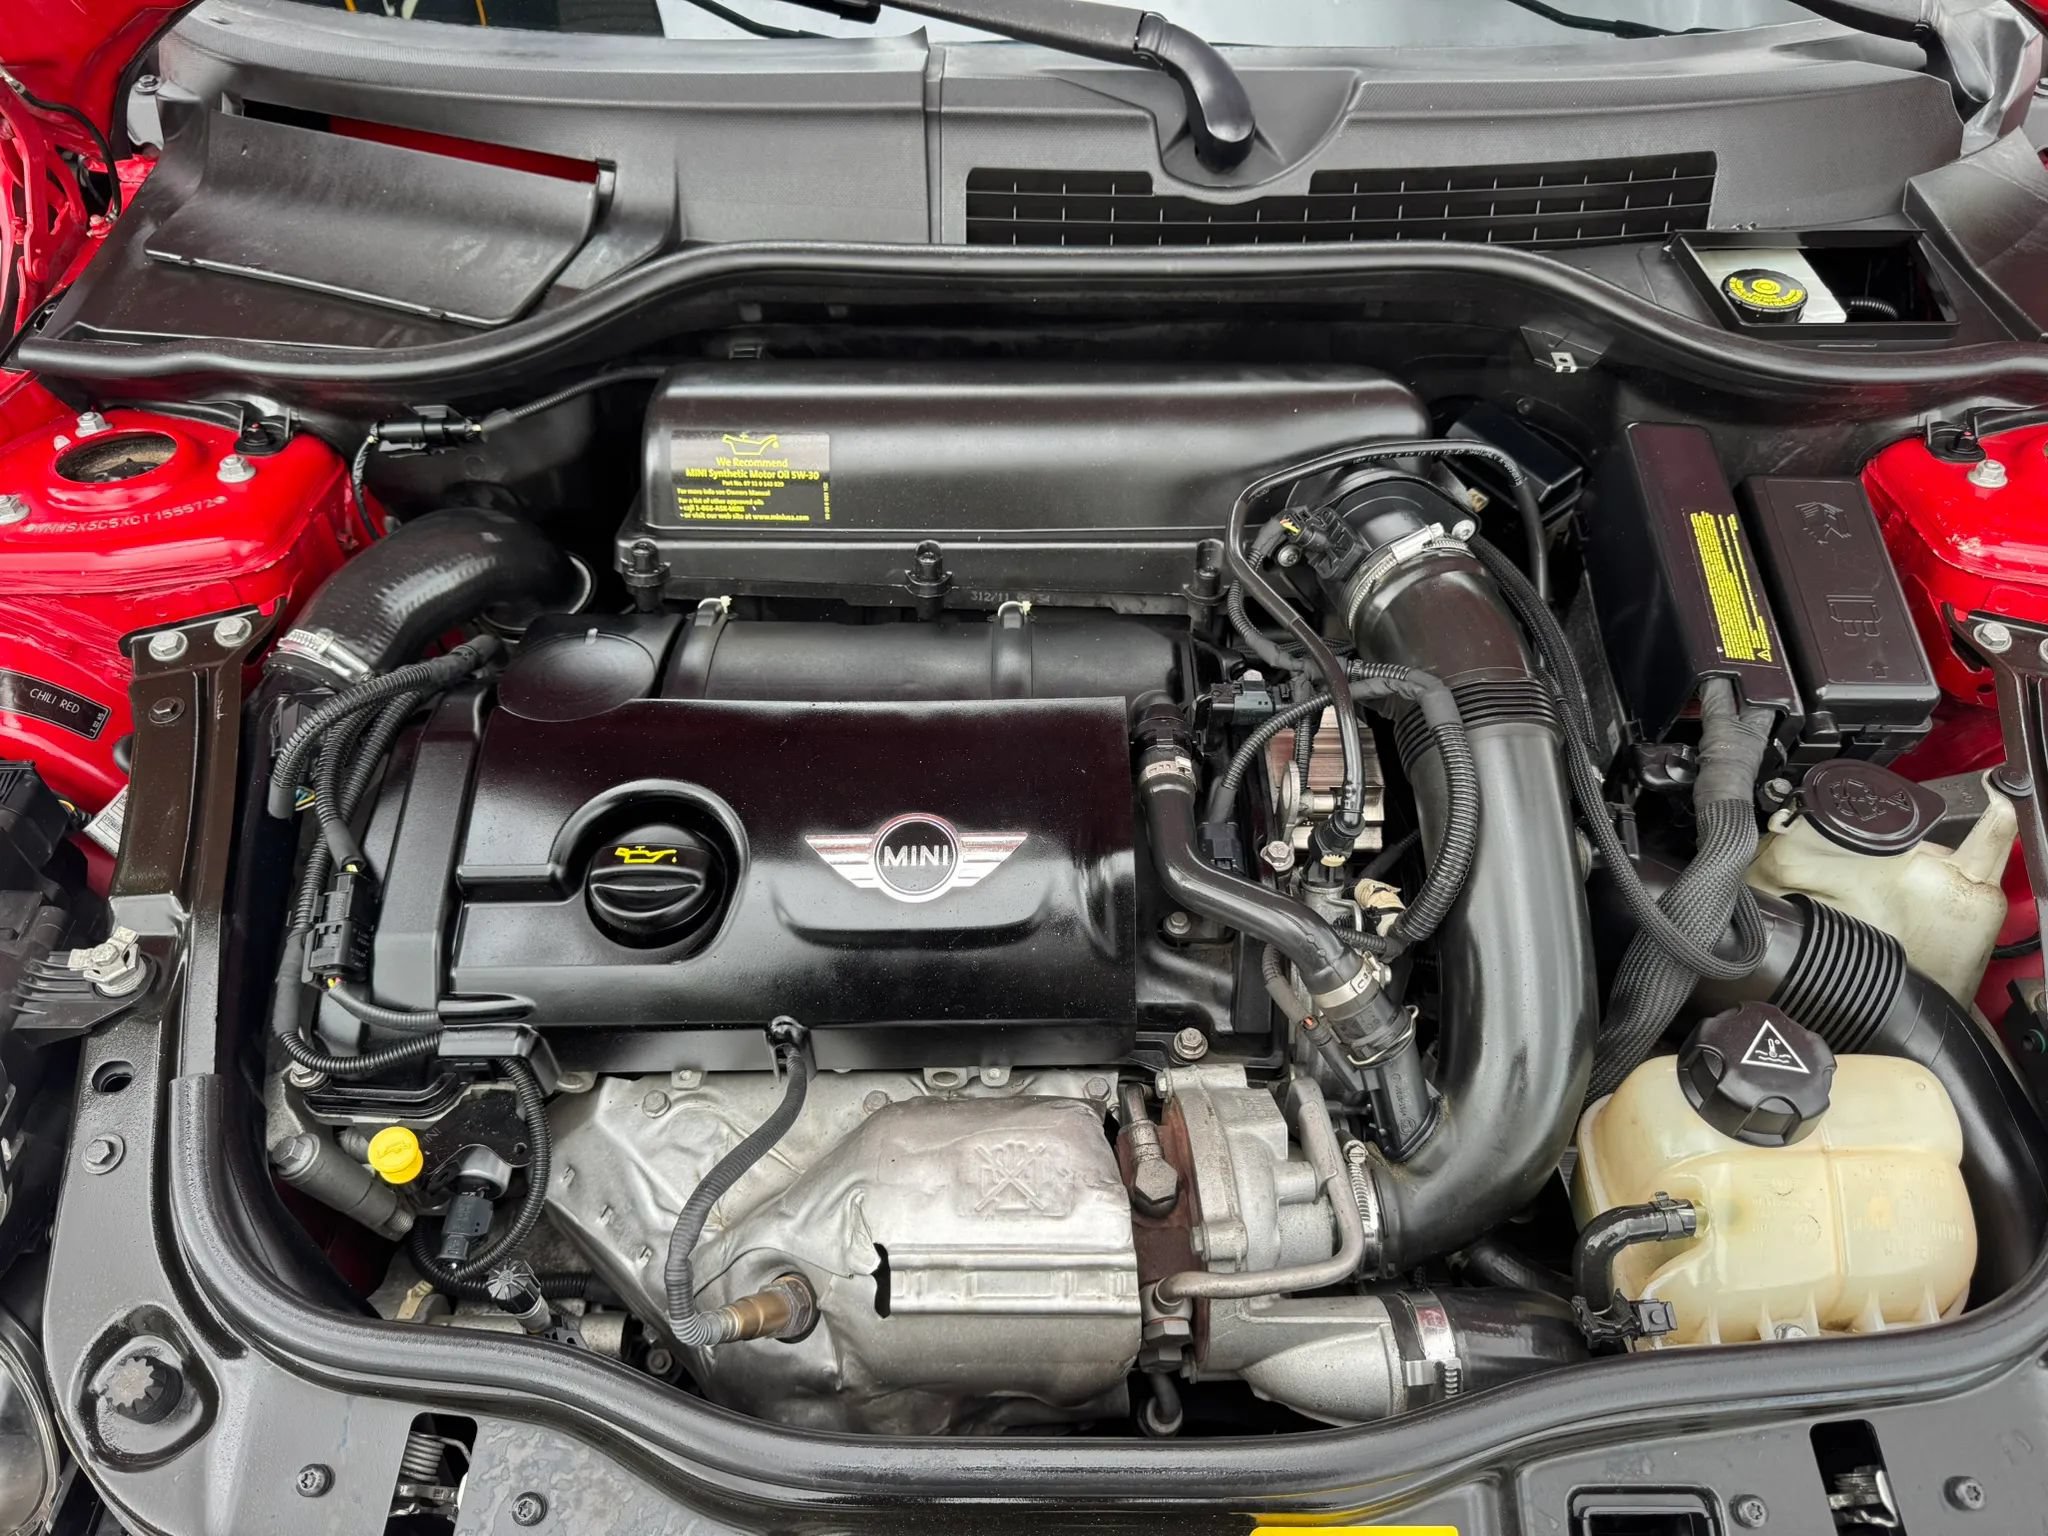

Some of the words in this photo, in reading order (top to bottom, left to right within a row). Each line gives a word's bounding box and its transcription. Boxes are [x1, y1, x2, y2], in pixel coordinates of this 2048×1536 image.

[716, 457, 731, 467] We
[733, 458, 788, 468] Recommend
[685, 468, 708, 478] MINI
[708, 469, 748, 480] Synthetic
[749, 470, 776, 479] Motor
[777, 470, 790, 479] Oil
[791, 471, 820, 480] 5W-30
[29, 688, 57, 704] CHILI
[59, 699, 80, 714] RED
[883, 844, 949, 867] MINI
